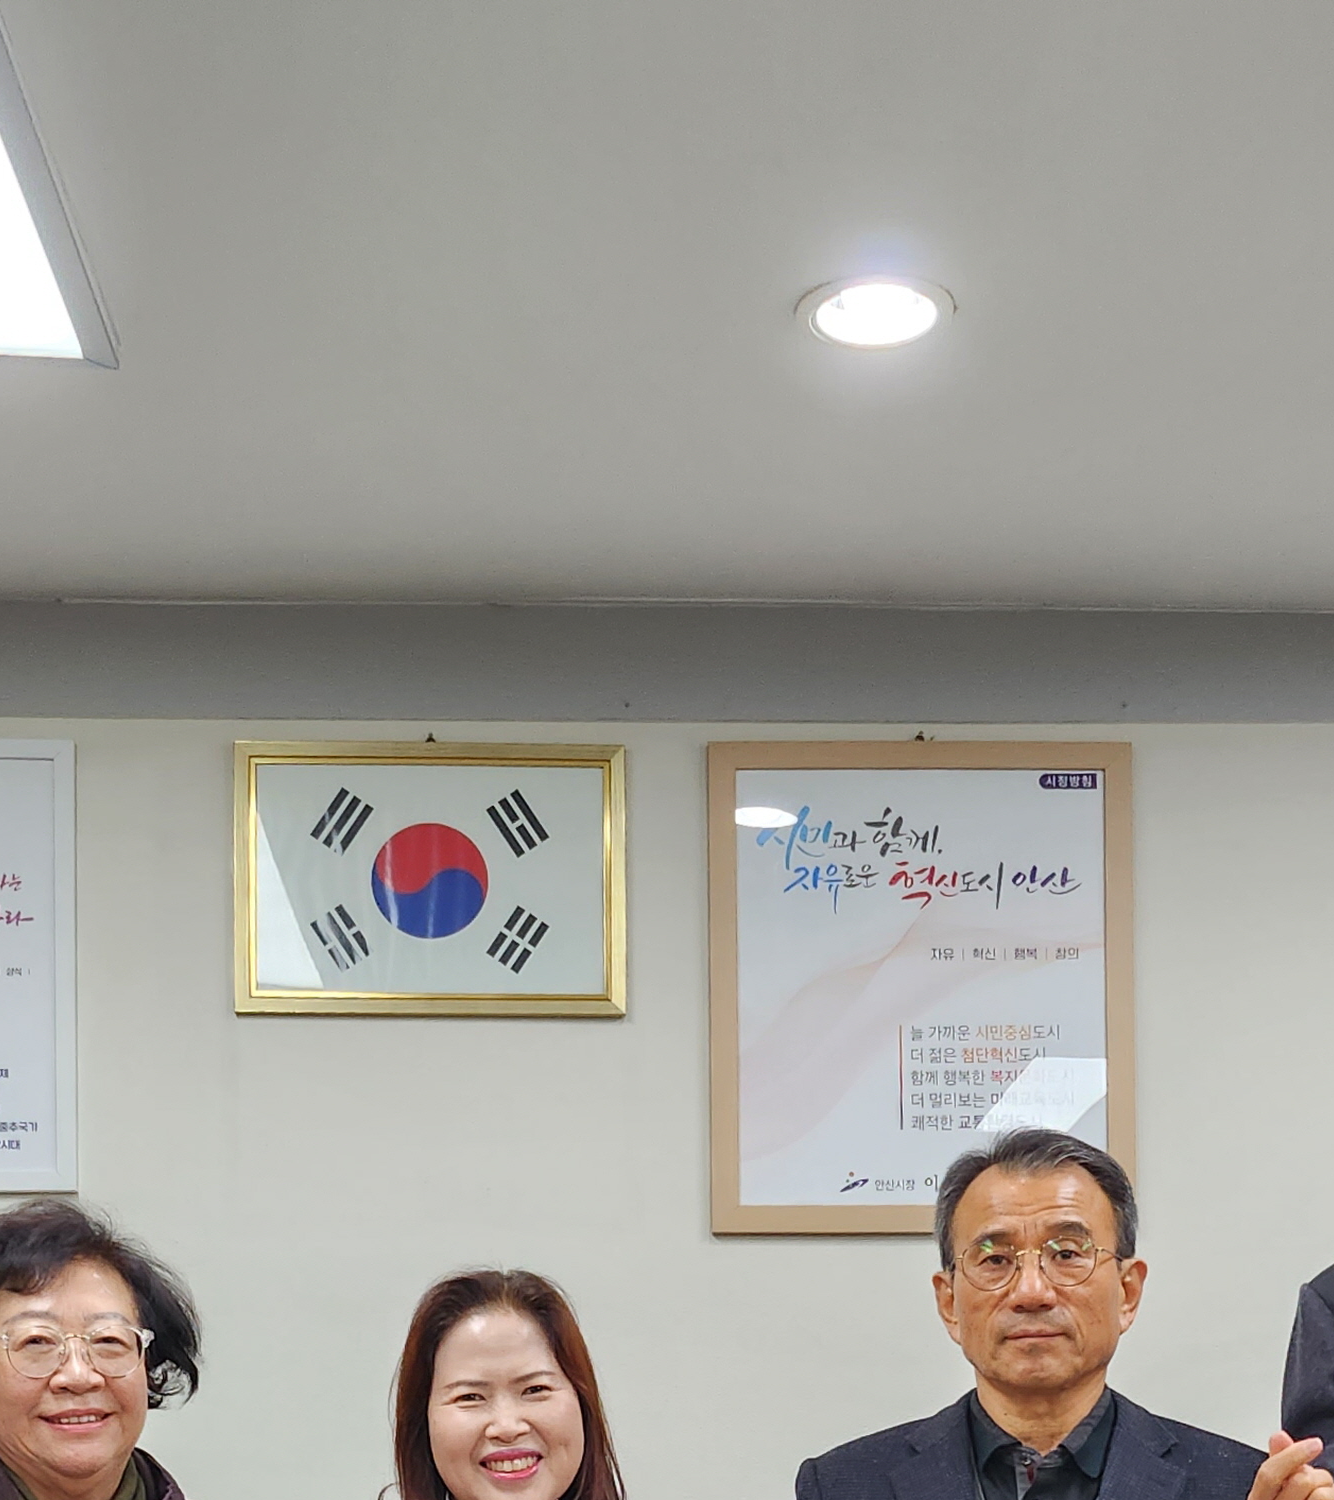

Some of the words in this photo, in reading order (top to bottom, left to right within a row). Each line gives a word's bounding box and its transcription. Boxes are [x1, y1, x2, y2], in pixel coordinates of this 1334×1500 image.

[757, 806, 866, 869] 시민과
[783, 863, 880, 915] 자유로운
[888, 861, 1005, 910] 혁신도시
[1012, 865, 1082, 895] 안산
[931, 947, 955, 962] 자유
[972, 947, 997, 961] 혁신
[1014, 947, 1038, 961] 행복
[1055, 947, 1079, 961] 창의
[910, 1025, 924, 1041] 늘
[928, 1025, 971, 1041] 가까운
[975, 1024, 1061, 1041] 시민중심도시
[910, 1047, 924, 1062] 더
[929, 1047, 958, 1063] 젊은
[961, 1046, 1046, 1063] 첨단혁신도시
[910, 1070, 939, 1086] 함께
[943, 1070, 985, 1086] 행복한
[910, 1092, 924, 1108] 더
[929, 1092, 986, 1108] 멀리보는
[910, 1114, 954, 1131] 쾌적한
[874, 1178, 916, 1192] 안산시장
